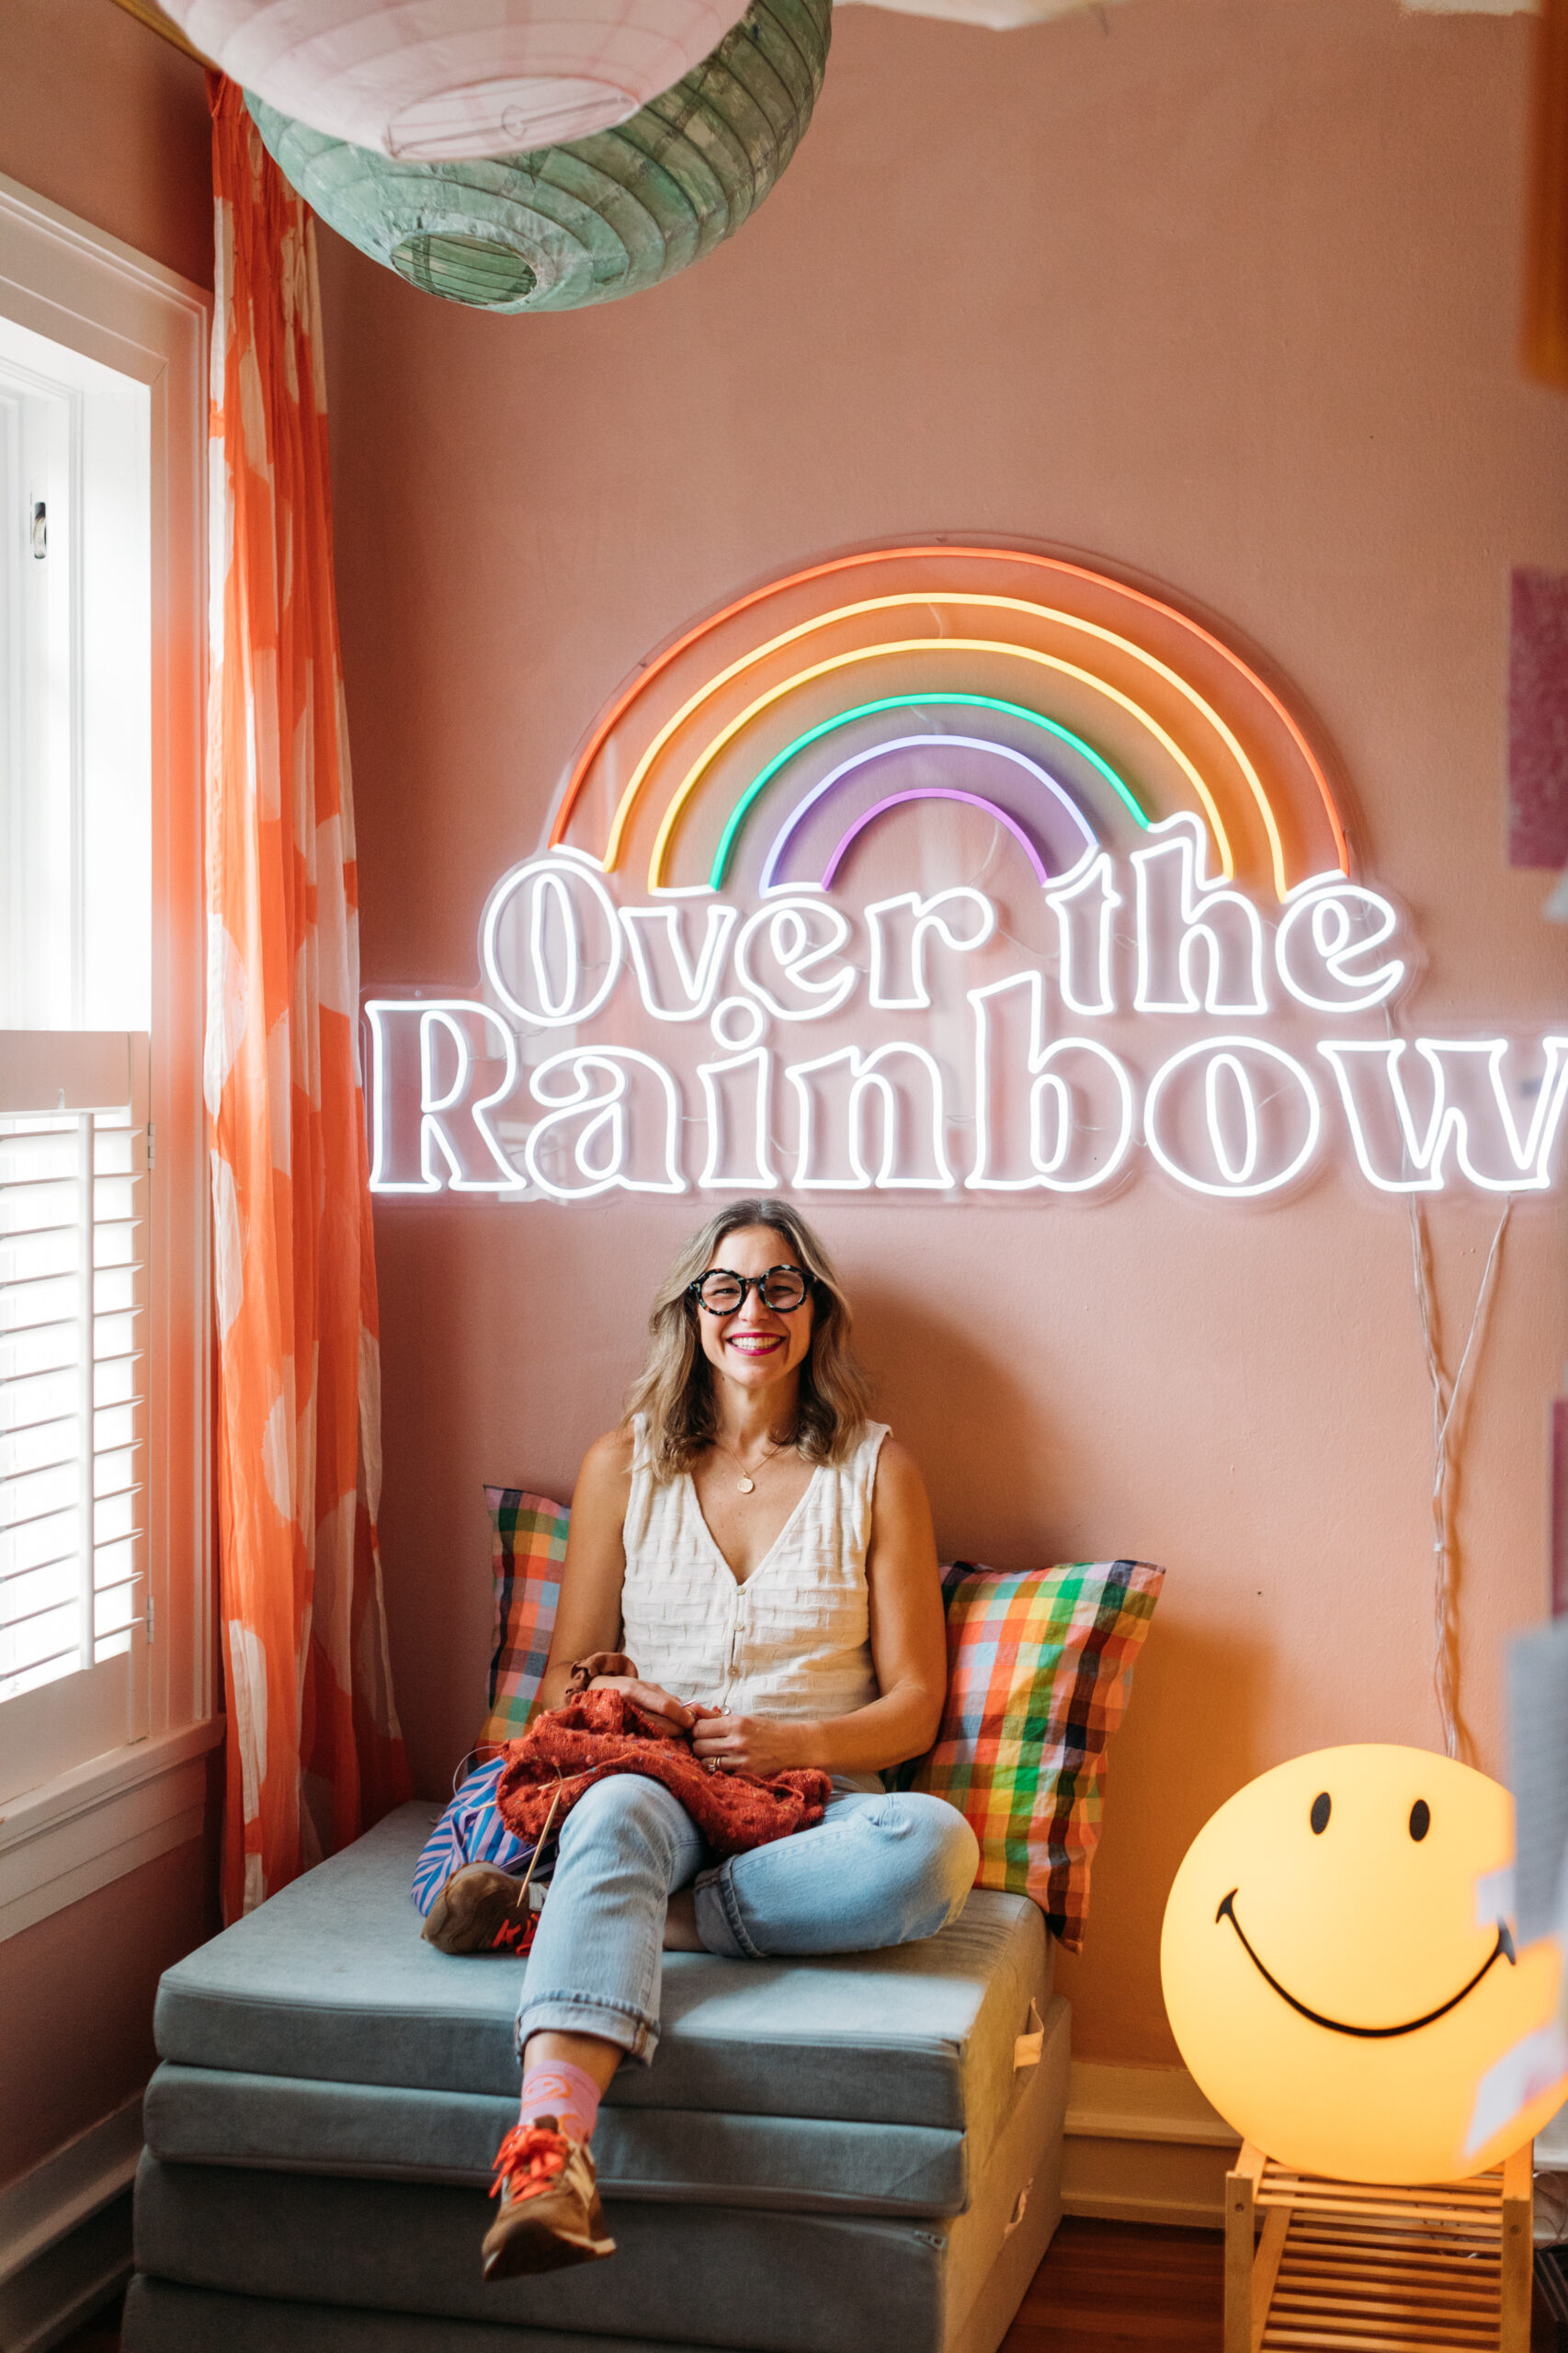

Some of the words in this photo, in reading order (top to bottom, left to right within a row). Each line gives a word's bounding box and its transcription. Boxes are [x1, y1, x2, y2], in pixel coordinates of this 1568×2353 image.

[483, 858, 995, 1027] Over
[1046, 836, 1404, 1012] the
[364, 970, 1568, 1199] Rainbow
